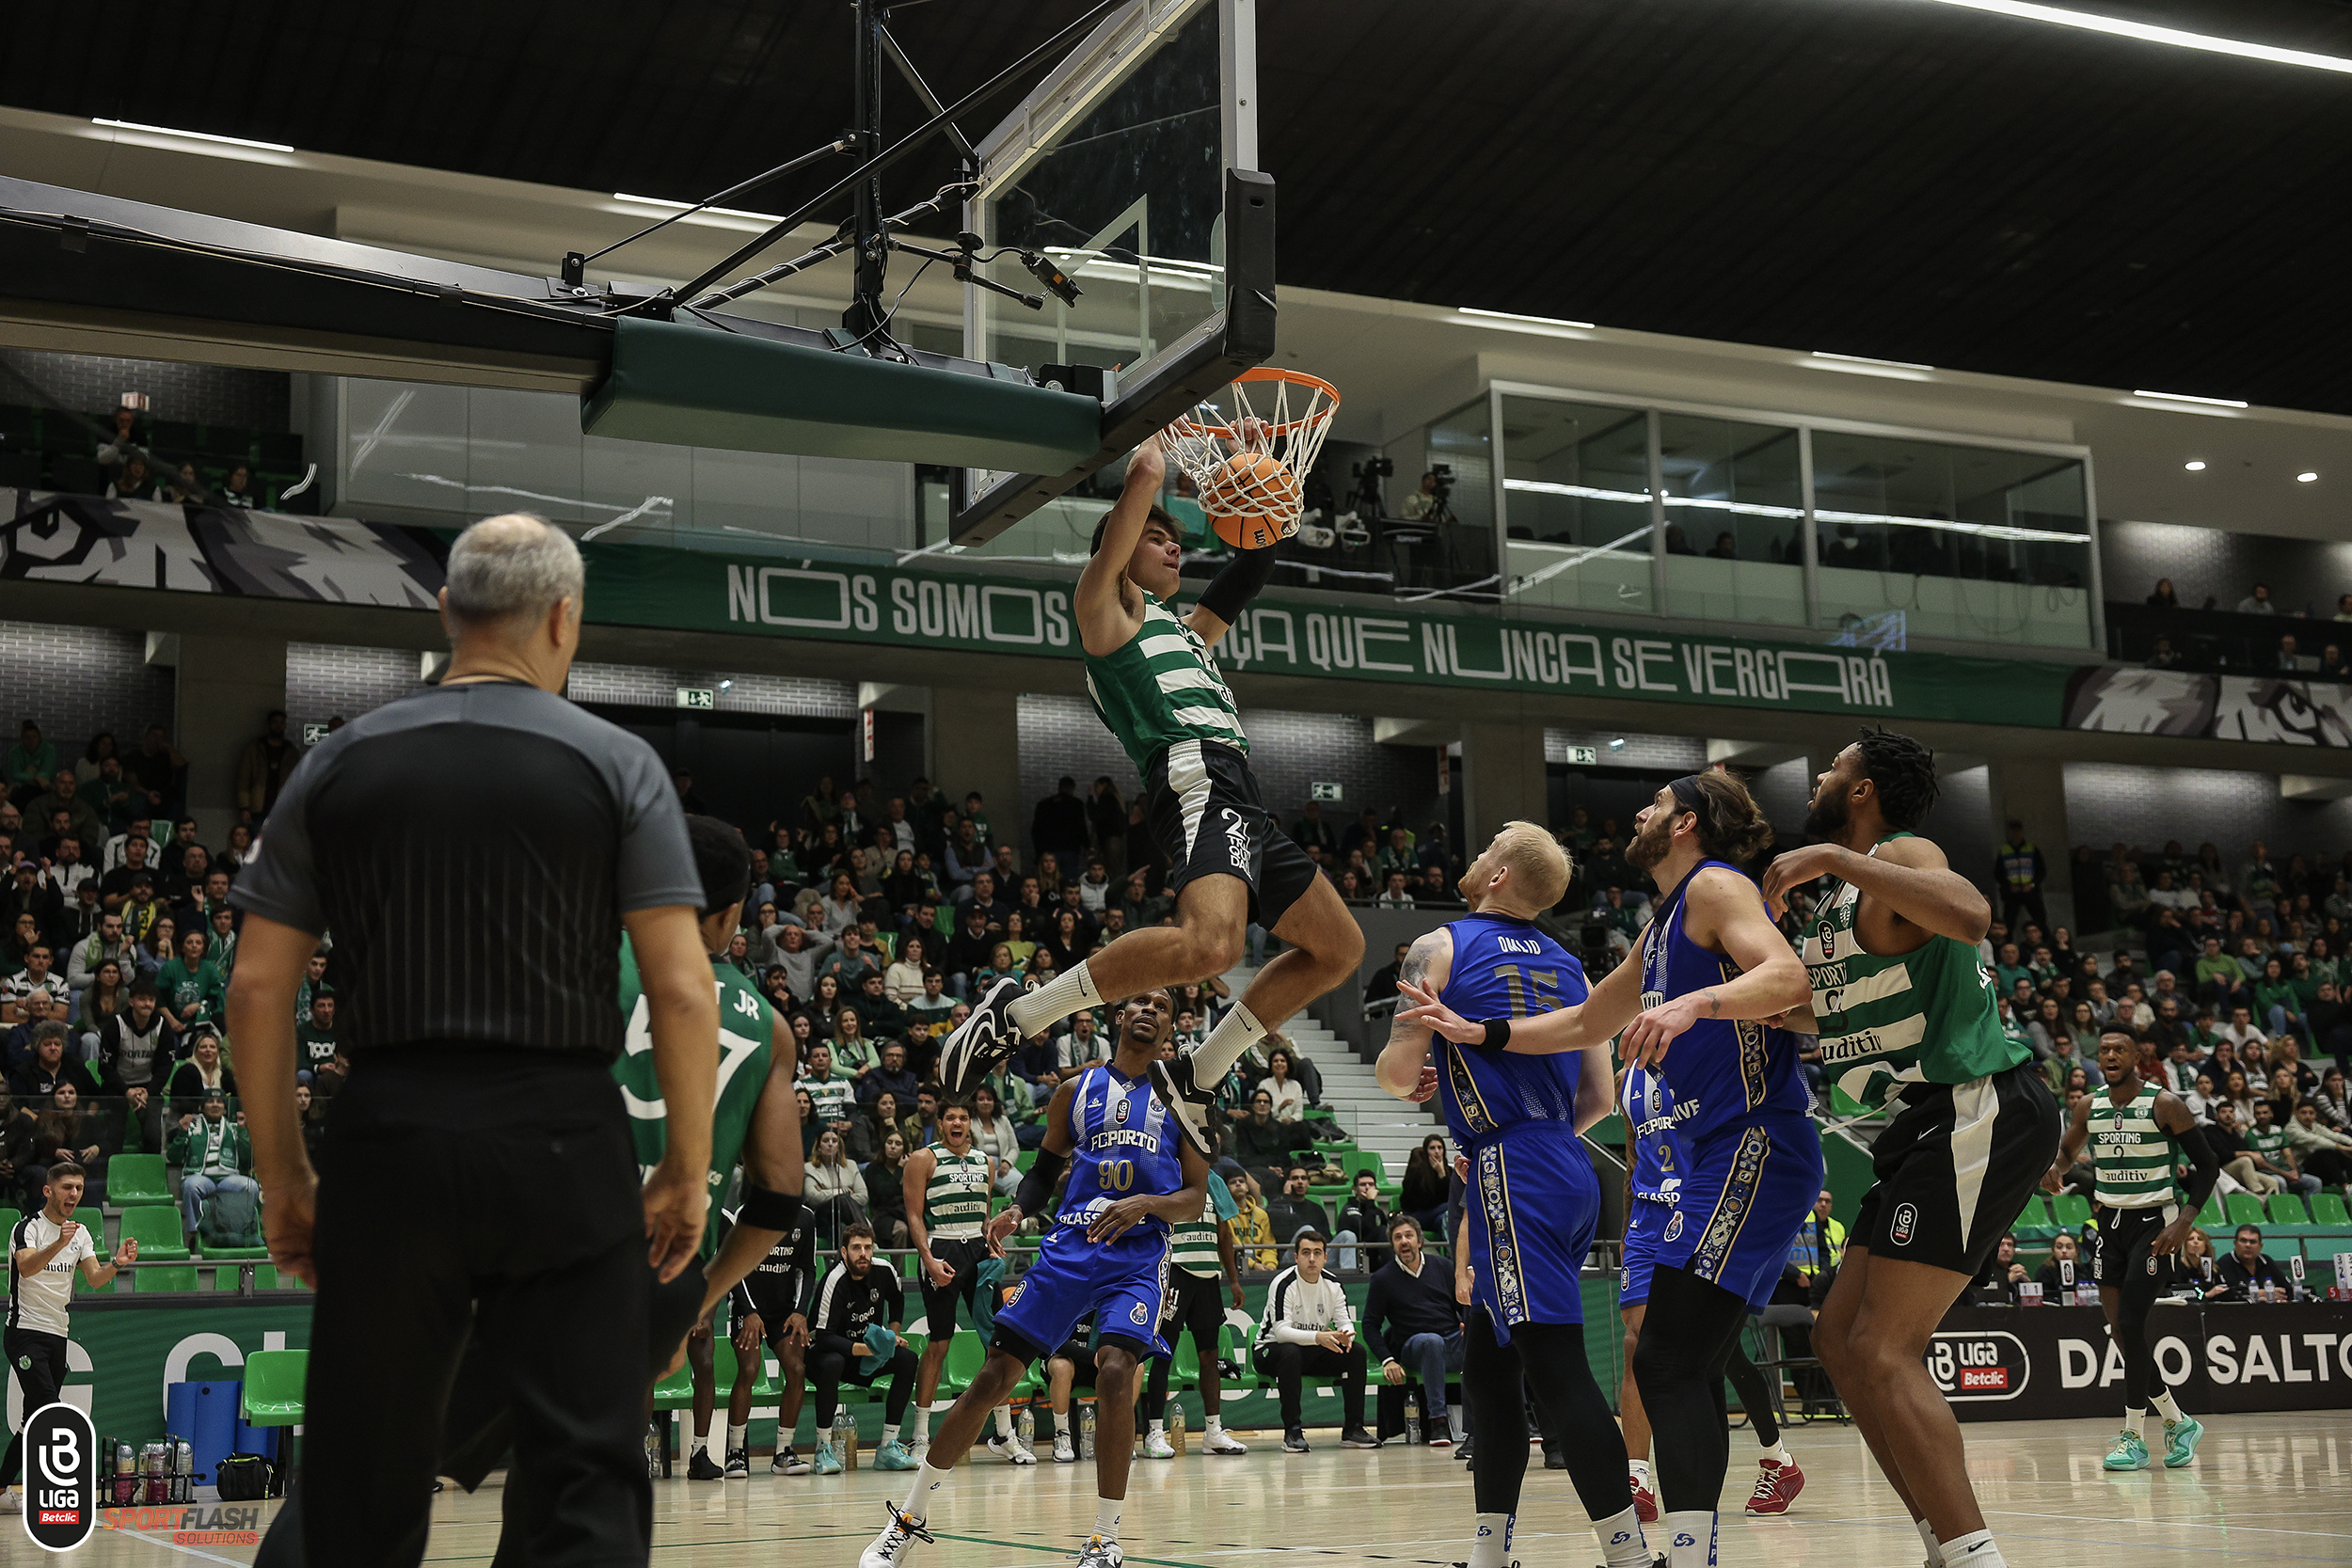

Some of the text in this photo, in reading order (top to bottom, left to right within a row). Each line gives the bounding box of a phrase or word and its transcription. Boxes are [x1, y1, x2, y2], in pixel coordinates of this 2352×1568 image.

[891, 577, 1071, 647] SOMOS
[1305, 612, 1413, 672] QUE
[1422, 622, 1605, 687] NUNCA
[1612, 637, 1677, 691] SE
[1681, 643, 1894, 707] VERGARÁ
[1497, 935, 1541, 955] OMLID
[733, 989, 760, 1021] JR
[1821, 1030, 1883, 1062] uditiv
[2098, 1132, 2141, 1144] SPORTING
[1658, 1145, 1675, 1172] 2
[2113, 1145, 2125, 1167] 2
[948, 1173, 984, 1183] SPORTING
[1098, 1159, 1135, 1192] 90
[2106, 1169, 2148, 1181] auditiv
[962, 1182, 973, 1200] 3
[1963, 1370, 2005, 1386] Betclic
